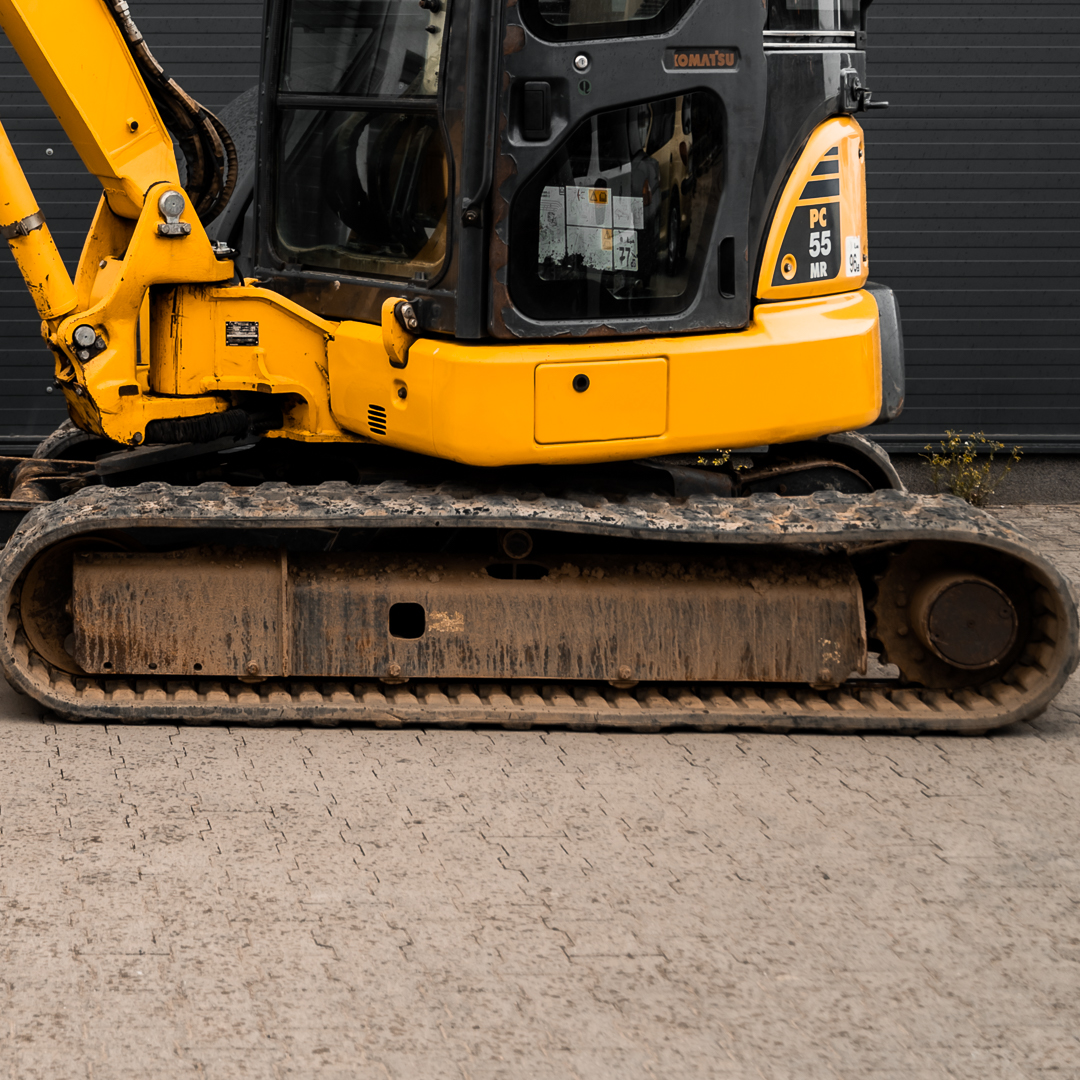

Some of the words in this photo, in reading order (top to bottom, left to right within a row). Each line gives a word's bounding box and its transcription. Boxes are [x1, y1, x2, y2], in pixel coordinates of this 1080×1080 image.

[809, 207, 827, 229] PC
[809, 230, 832, 258] 55
[810, 261, 828, 279] MR
